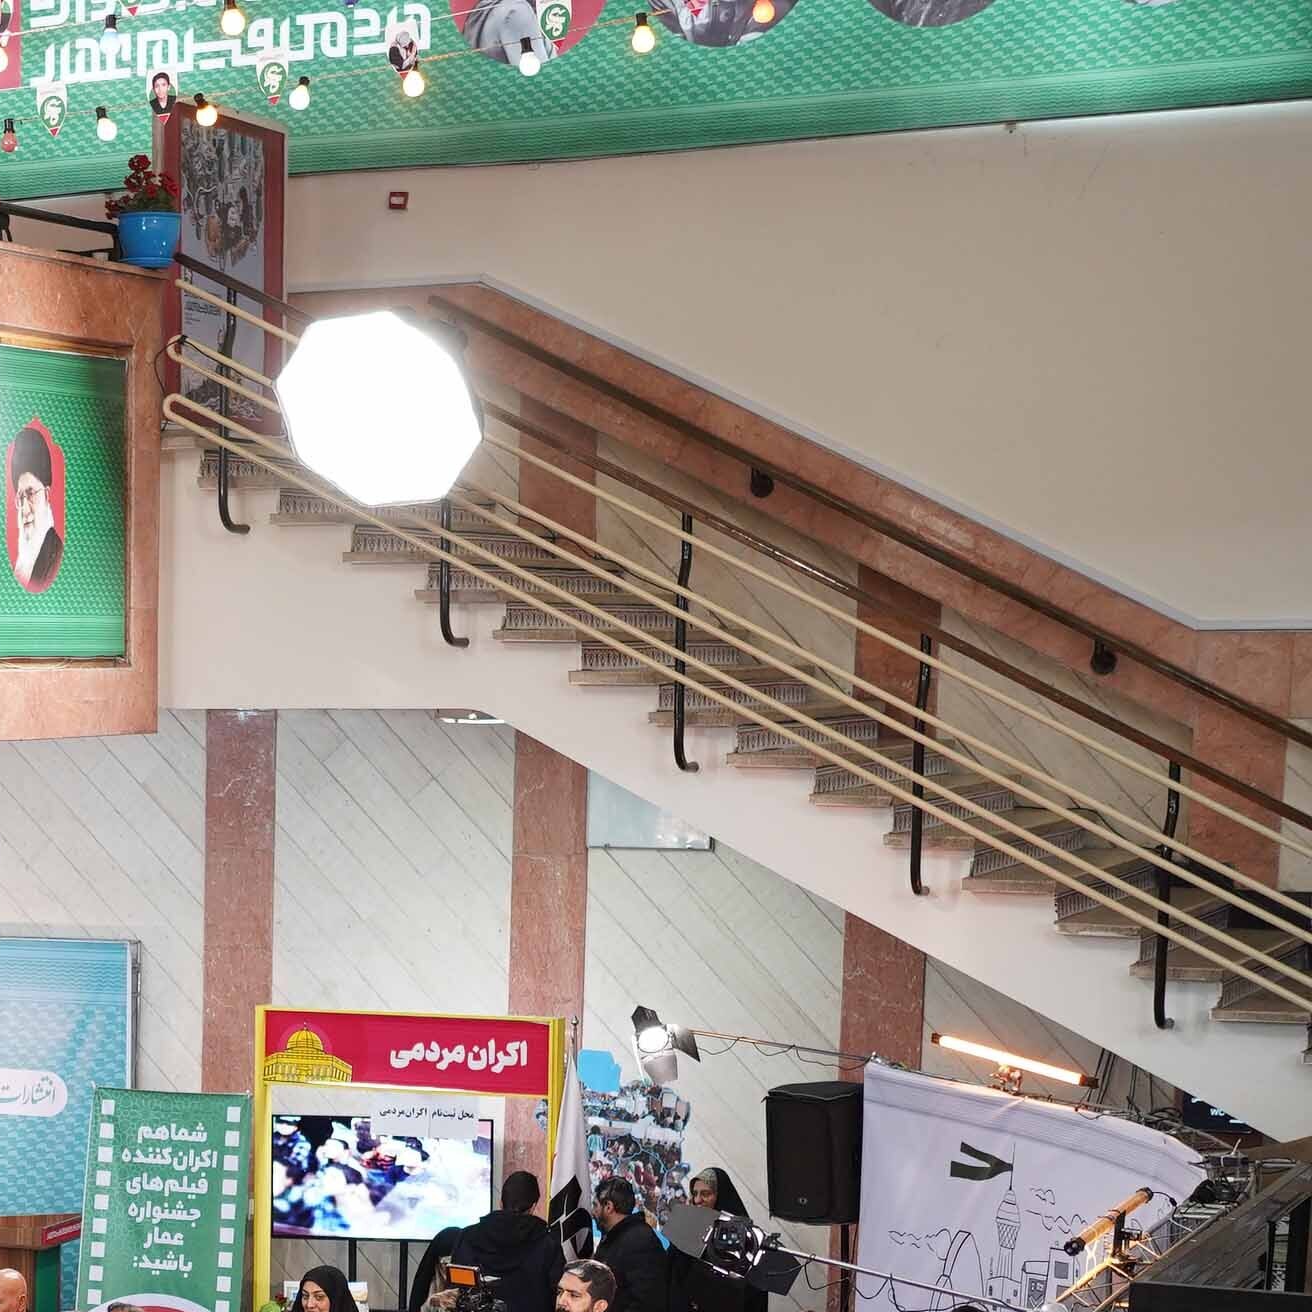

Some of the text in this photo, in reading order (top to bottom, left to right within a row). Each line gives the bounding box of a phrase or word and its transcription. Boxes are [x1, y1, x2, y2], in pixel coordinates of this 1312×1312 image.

[389, 1037, 529, 1075] اکران مردمی
[457, 1109, 474, 1121] محل
[127, 1200, 202, 1229] جشنواره
[143, 1226, 185, 1250] عمار
